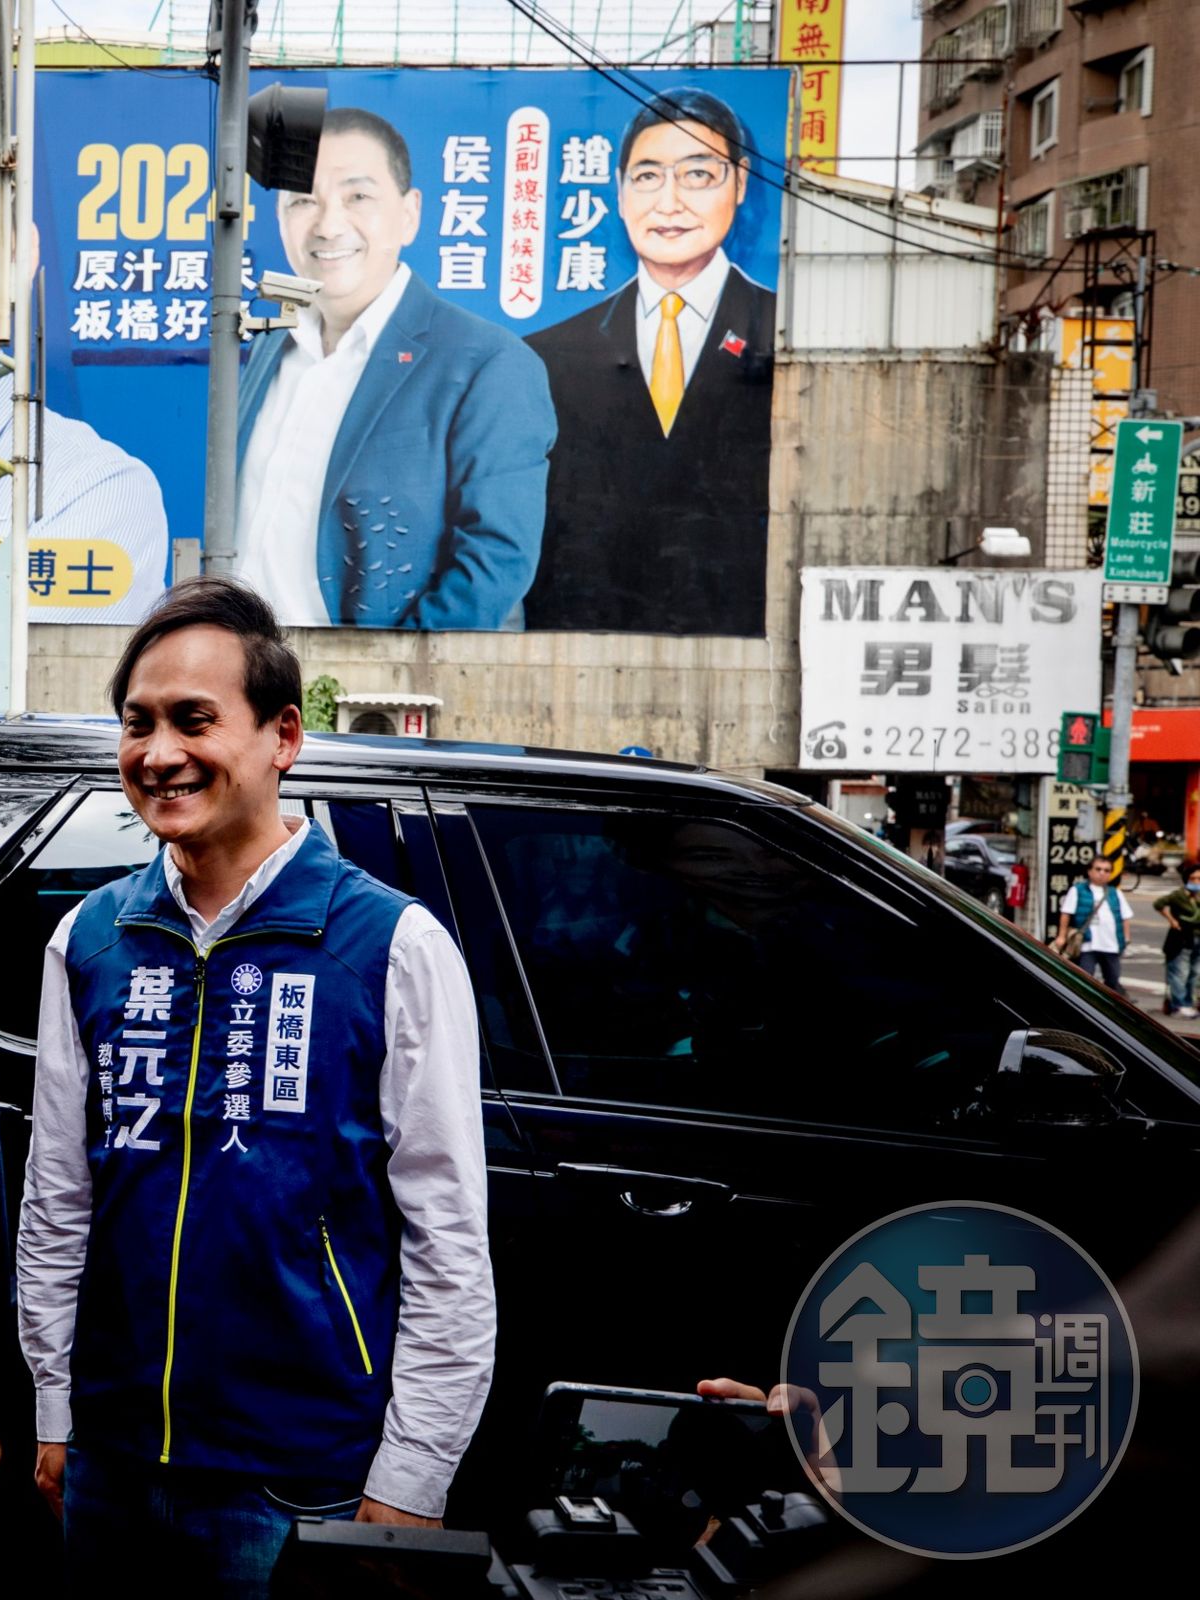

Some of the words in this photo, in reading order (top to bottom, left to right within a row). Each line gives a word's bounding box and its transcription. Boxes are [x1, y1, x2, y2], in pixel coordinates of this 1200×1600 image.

[437, 135, 492, 290] 侯友宜
[509, 123, 544, 303] 正副總統候選人
[555, 134, 613, 292] 趙少康
[70, 298, 255, 342] 板橋好
[1128, 479, 1157, 535] 新莊
[1109, 552, 1134, 563] Lane
[1143, 553, 1155, 564] to
[1110, 536, 1168, 551] Motorcycle
[819, 575, 1078, 625] MAN'S
[1109, 567, 1164, 582] Xinzhuang
[957, 700, 1031, 714] Salon
[1050, 846, 1094, 865] 249
[114, 966, 174, 1151] 葉元之
[272, 982, 306, 1102] 板橋東區
[221, 998, 257, 1154] 立委參選人
